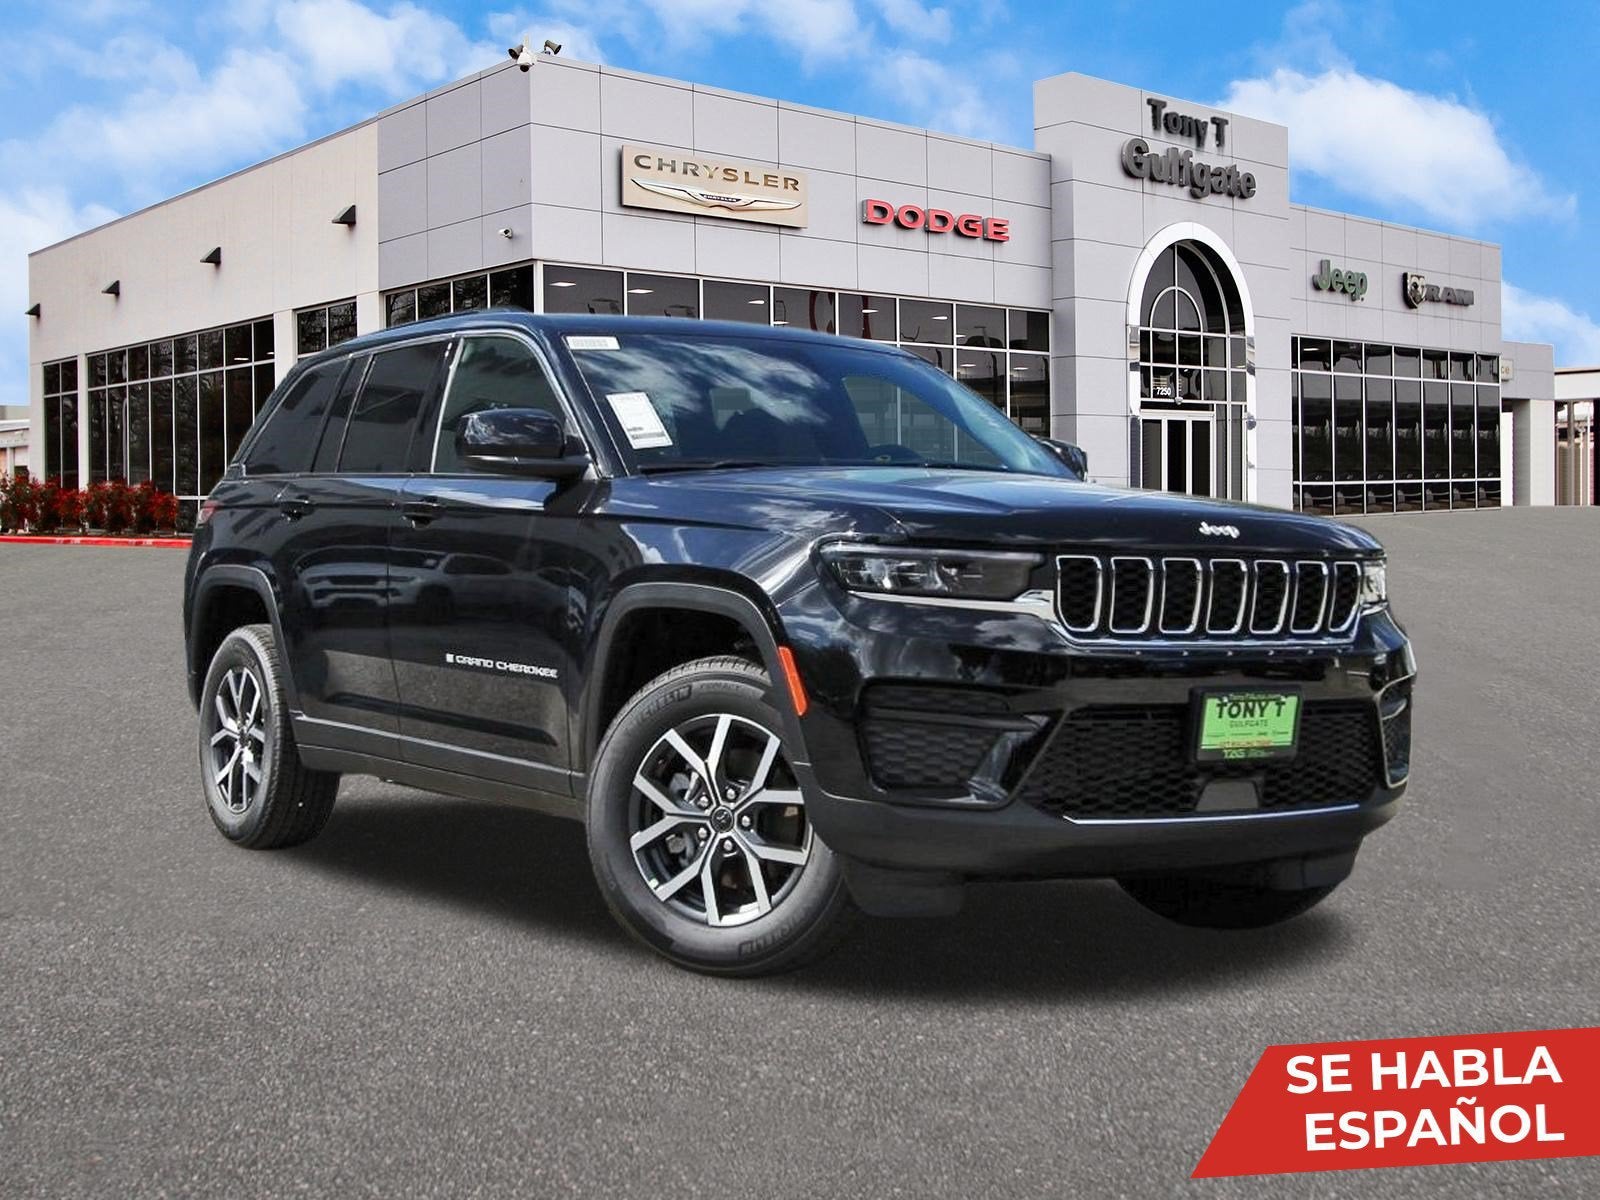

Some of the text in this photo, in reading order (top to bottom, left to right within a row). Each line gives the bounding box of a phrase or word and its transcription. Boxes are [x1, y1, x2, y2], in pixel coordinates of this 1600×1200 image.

[1146, 98, 1229, 148] Tony T
[633, 154, 801, 192] CHRYSLER
[1121, 137, 1257, 199] Gulfgate
[861, 198, 1010, 243] DODGE
[1312, 259, 1368, 302] Jeep
[1424, 283, 1475, 307] RAM
[1198, 521, 1240, 539] Jeep
[455, 654, 558, 679] GRAND CHEROKEE
[1216, 698, 1286, 719] TONY T
